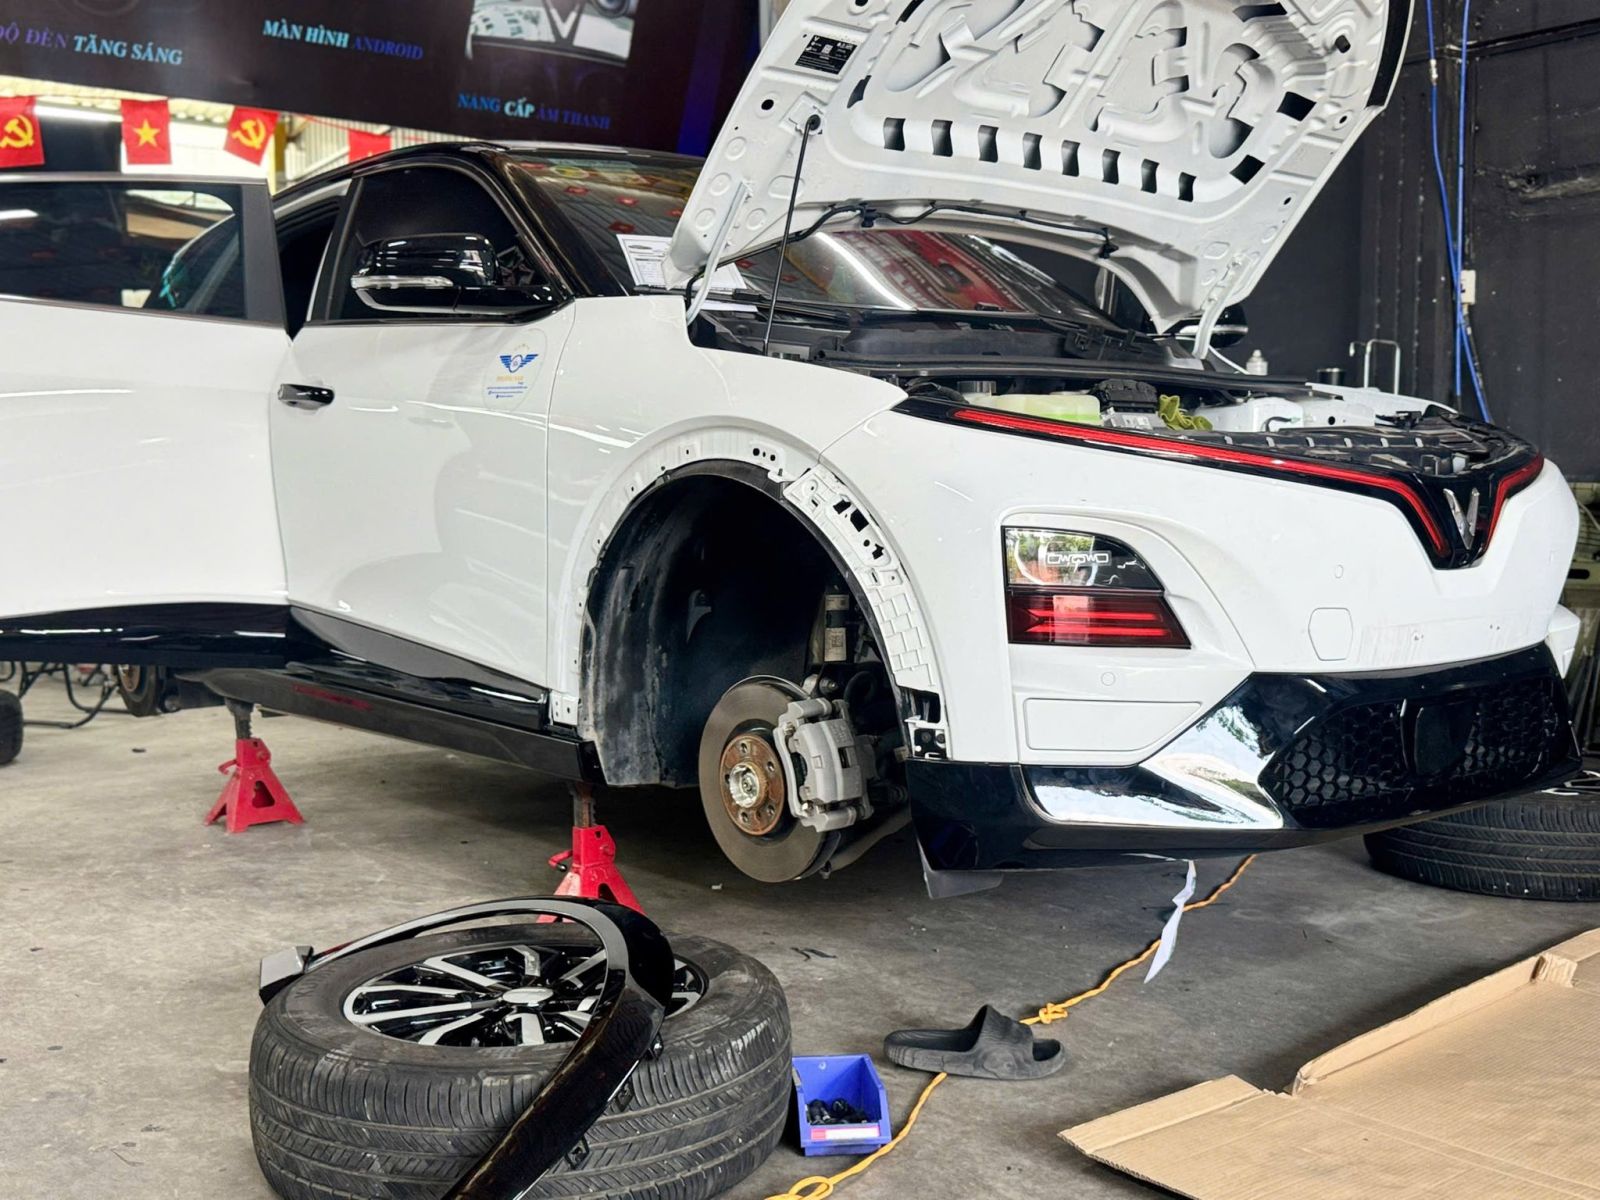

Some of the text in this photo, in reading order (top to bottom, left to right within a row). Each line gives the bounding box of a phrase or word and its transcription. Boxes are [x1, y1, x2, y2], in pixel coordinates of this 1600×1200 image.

[74, 33, 128, 59] TĂNG
[130, 41, 183, 66] SÁNG
[262, 18, 423, 59] MÀN HÌNH ANDROID
[504, 97, 535, 118] CẤP
[562, 109, 612, 129] THANH
